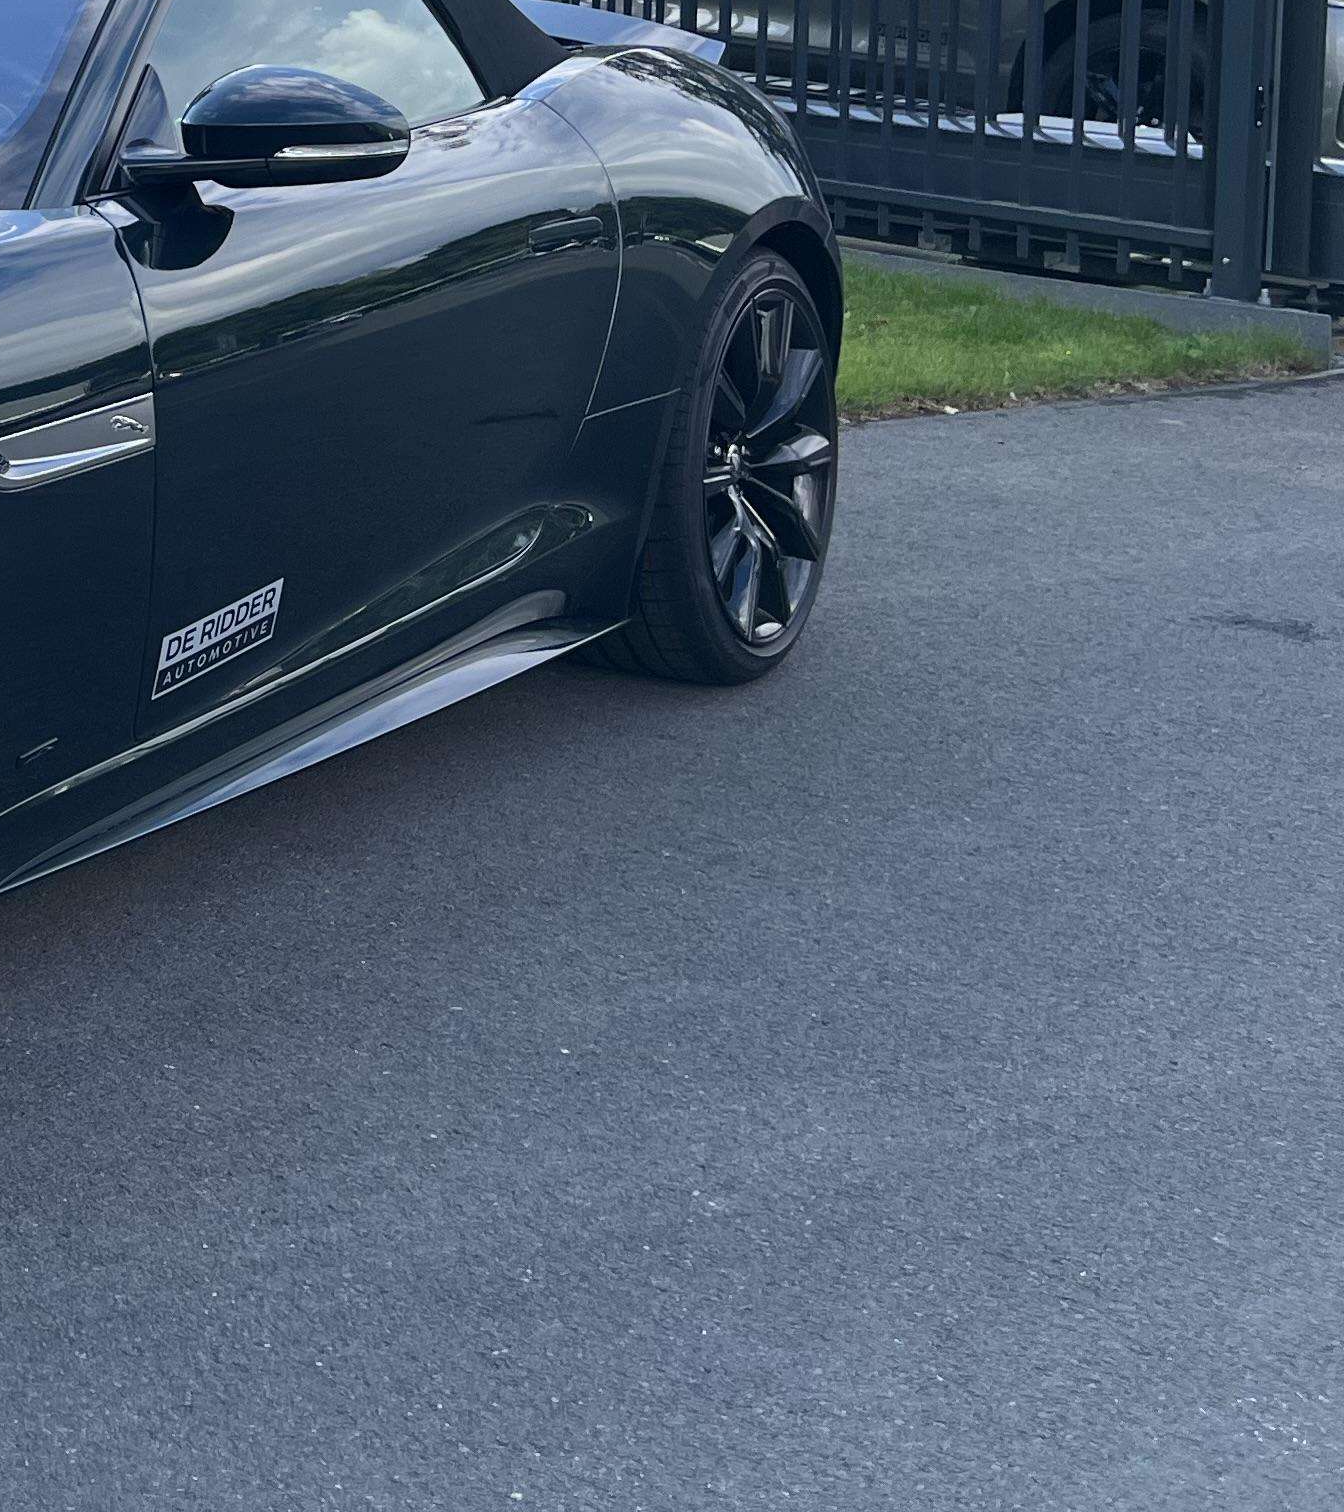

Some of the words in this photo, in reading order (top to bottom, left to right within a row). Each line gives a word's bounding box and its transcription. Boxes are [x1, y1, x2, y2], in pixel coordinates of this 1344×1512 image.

[162, 619, 269, 687] AUTOMOTIVE
[165, 626, 197, 662] DE
[199, 587, 277, 646] RIDDER
